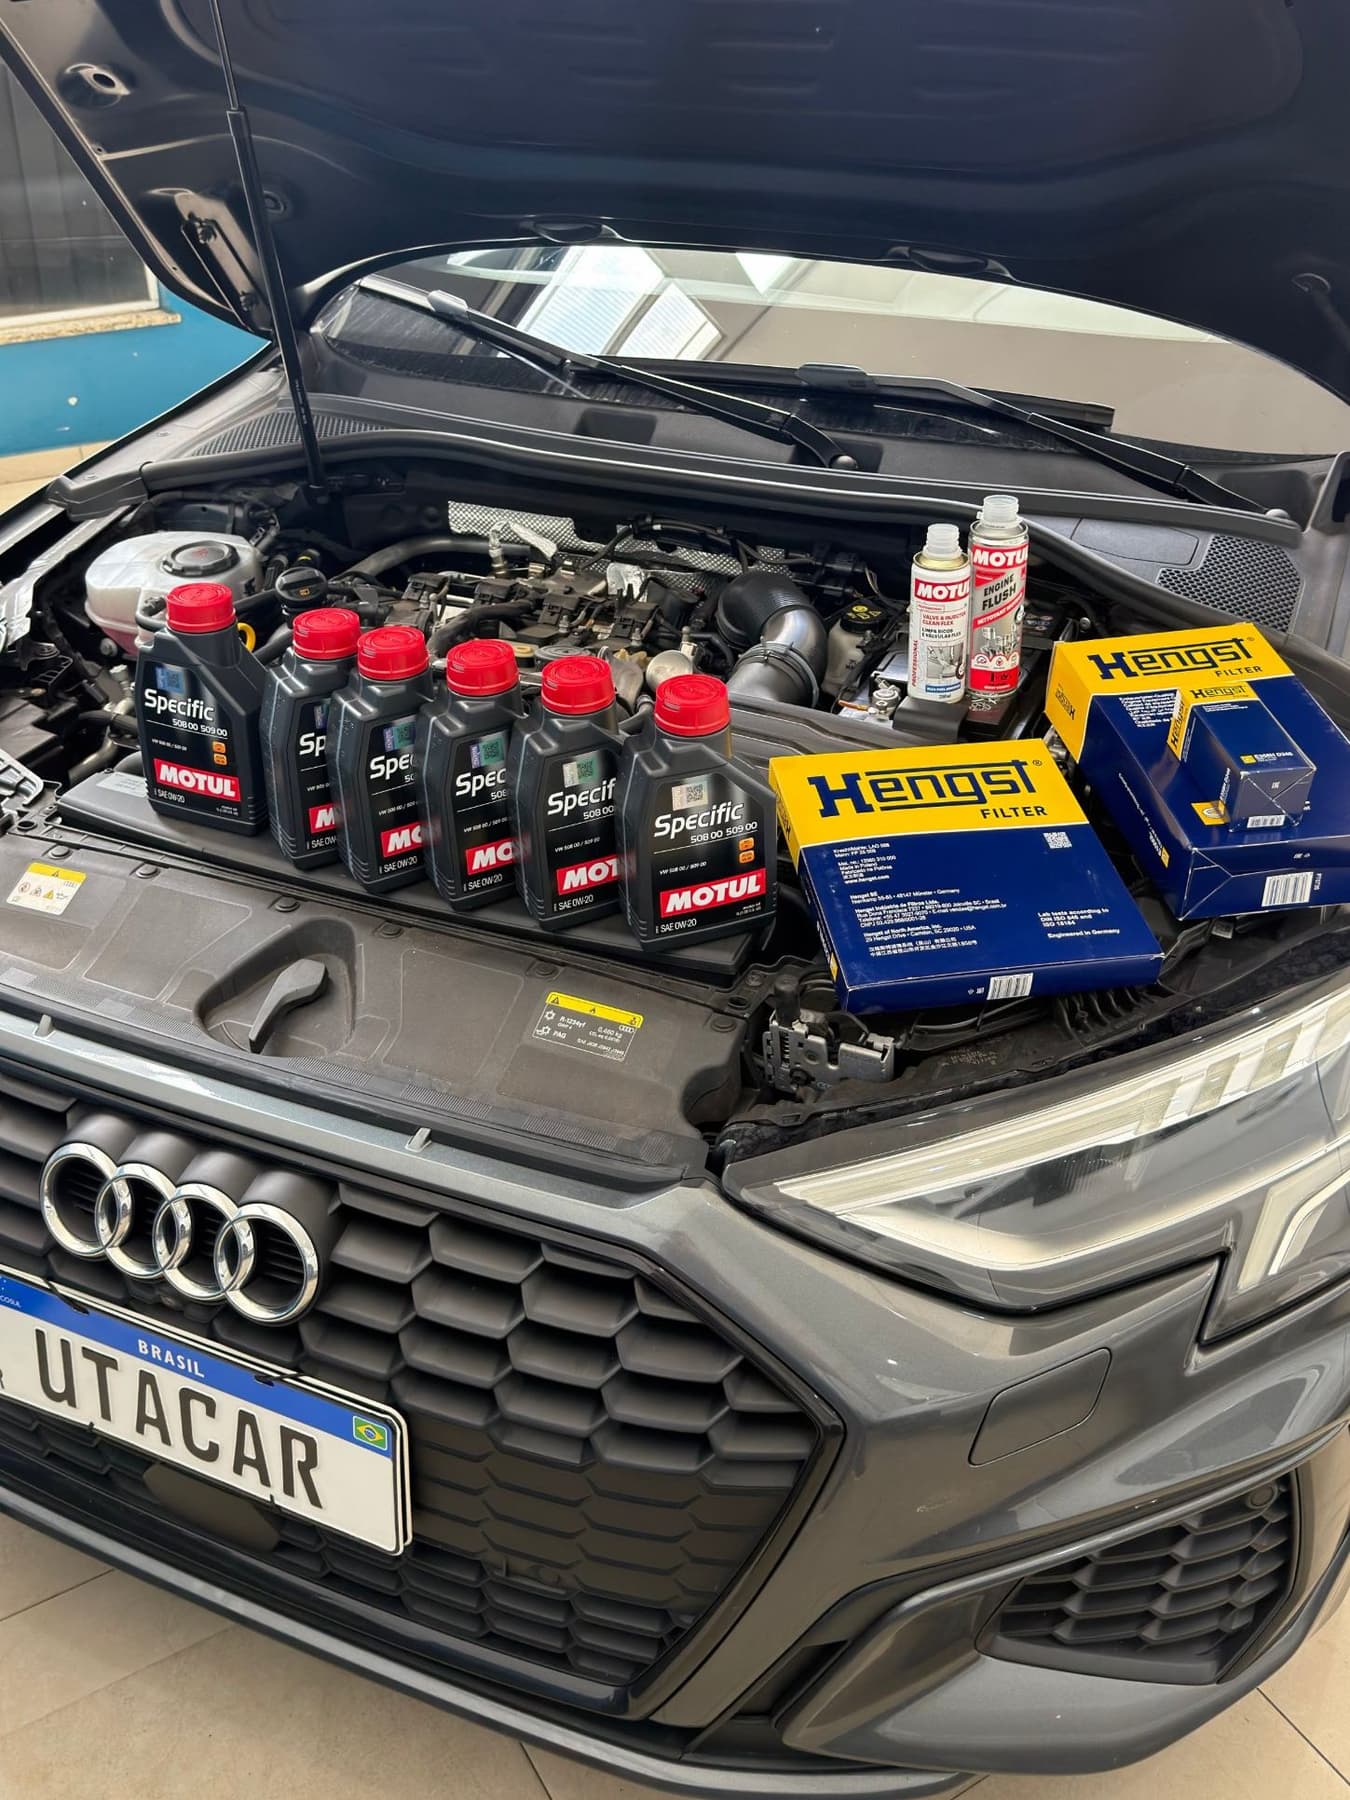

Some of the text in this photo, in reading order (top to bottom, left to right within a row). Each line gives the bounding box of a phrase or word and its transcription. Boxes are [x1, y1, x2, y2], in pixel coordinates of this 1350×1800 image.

[984, 573, 1014, 597] ENGINE
[982, 583, 1016, 611] FLUSH
[1087, 638, 1253, 680] Hengst
[1215, 666, 1263, 678] FILTER
[1190, 685, 1247, 699] Hengst
[144, 688, 214, 721] Specific
[172, 718, 228, 737] 508 00 509 00
[160, 764, 236, 798] MOTUL
[807, 760, 1037, 818] Hengst
[547, 777, 616, 816] Specif
[584, 808, 600, 820] 508
[654, 801, 744, 839] Specific
[981, 804, 1048, 820] FILTER
[311, 838, 324, 850] SAE
[690, 822, 758, 844] 508 00 509 00
[384, 861, 397, 874] SAE
[563, 858, 619, 891] MOT
[468, 879, 482, 891] SAE
[666, 875, 761, 913] MOTUL
[559, 900, 572, 912] SAE
[1068, 908, 1101, 916] according
[660, 922, 674, 934] SAE
[1048, 930, 1084, 939] Engineered
[138, 1338, 205, 1378] BRASIL
[35, 1328, 324, 1510] UTACAR
